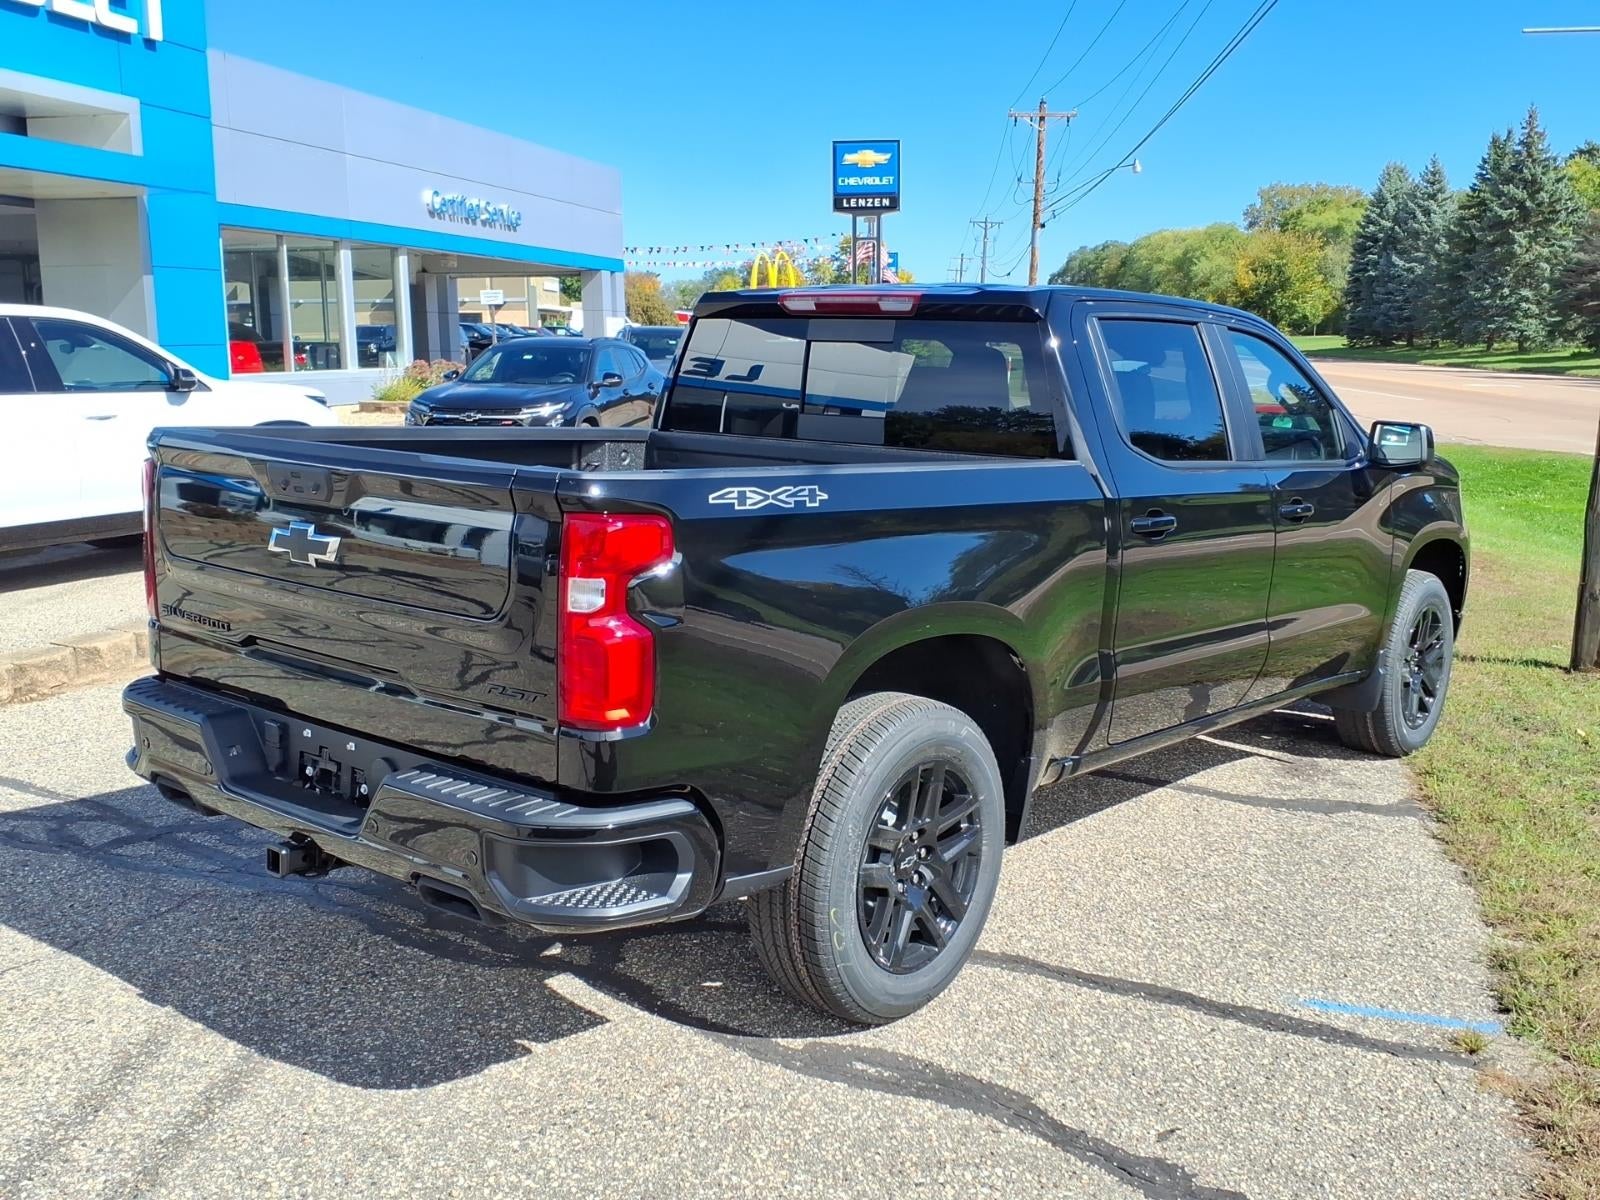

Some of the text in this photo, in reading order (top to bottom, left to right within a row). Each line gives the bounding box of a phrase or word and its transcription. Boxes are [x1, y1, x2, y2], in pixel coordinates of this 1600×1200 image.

[838, 176, 895, 186] CHEVROLET
[425, 190, 522, 230] Certified Service
[843, 198, 890, 207] LENZEN
[487, 682, 548, 703] RST
